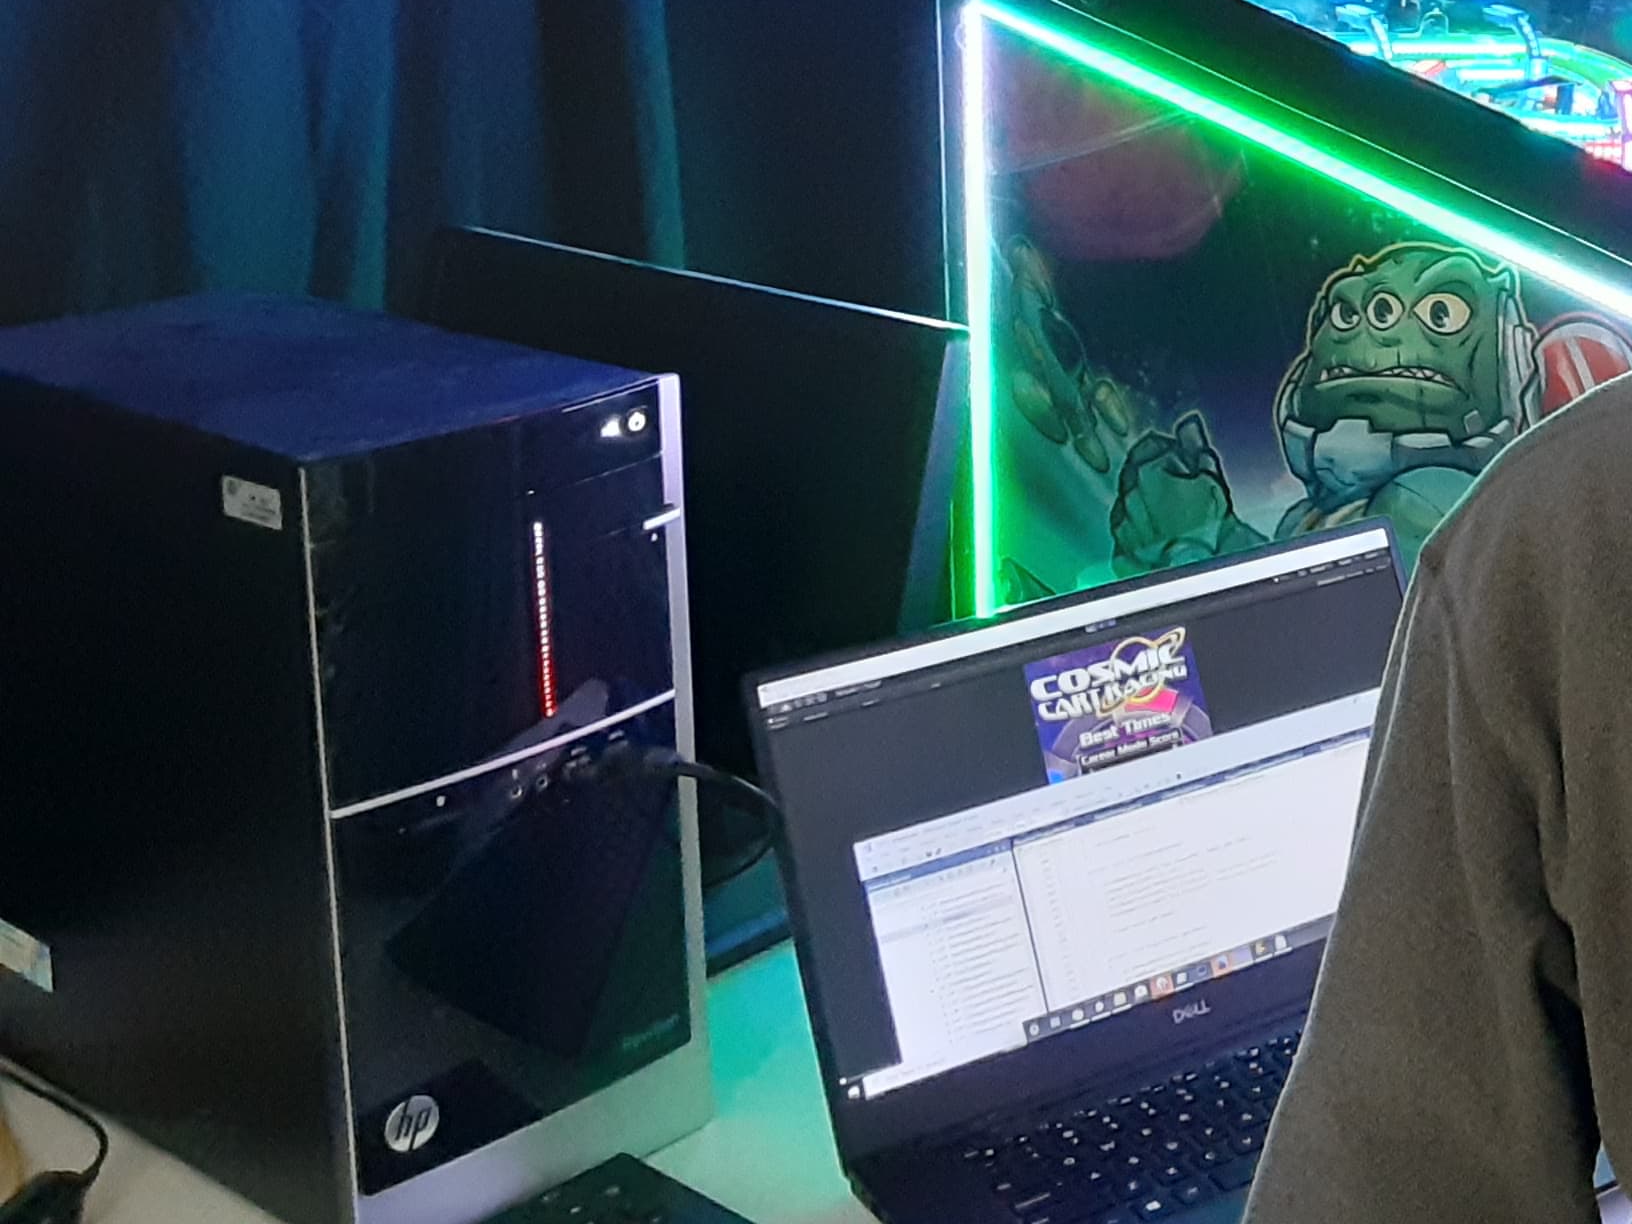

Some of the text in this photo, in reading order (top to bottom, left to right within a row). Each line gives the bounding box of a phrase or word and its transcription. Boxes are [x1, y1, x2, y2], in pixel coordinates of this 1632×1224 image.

[1030, 642, 1186, 702] COSMIC
[1079, 713, 1172, 749] Best Times
[393, 1098, 434, 1151] hp
